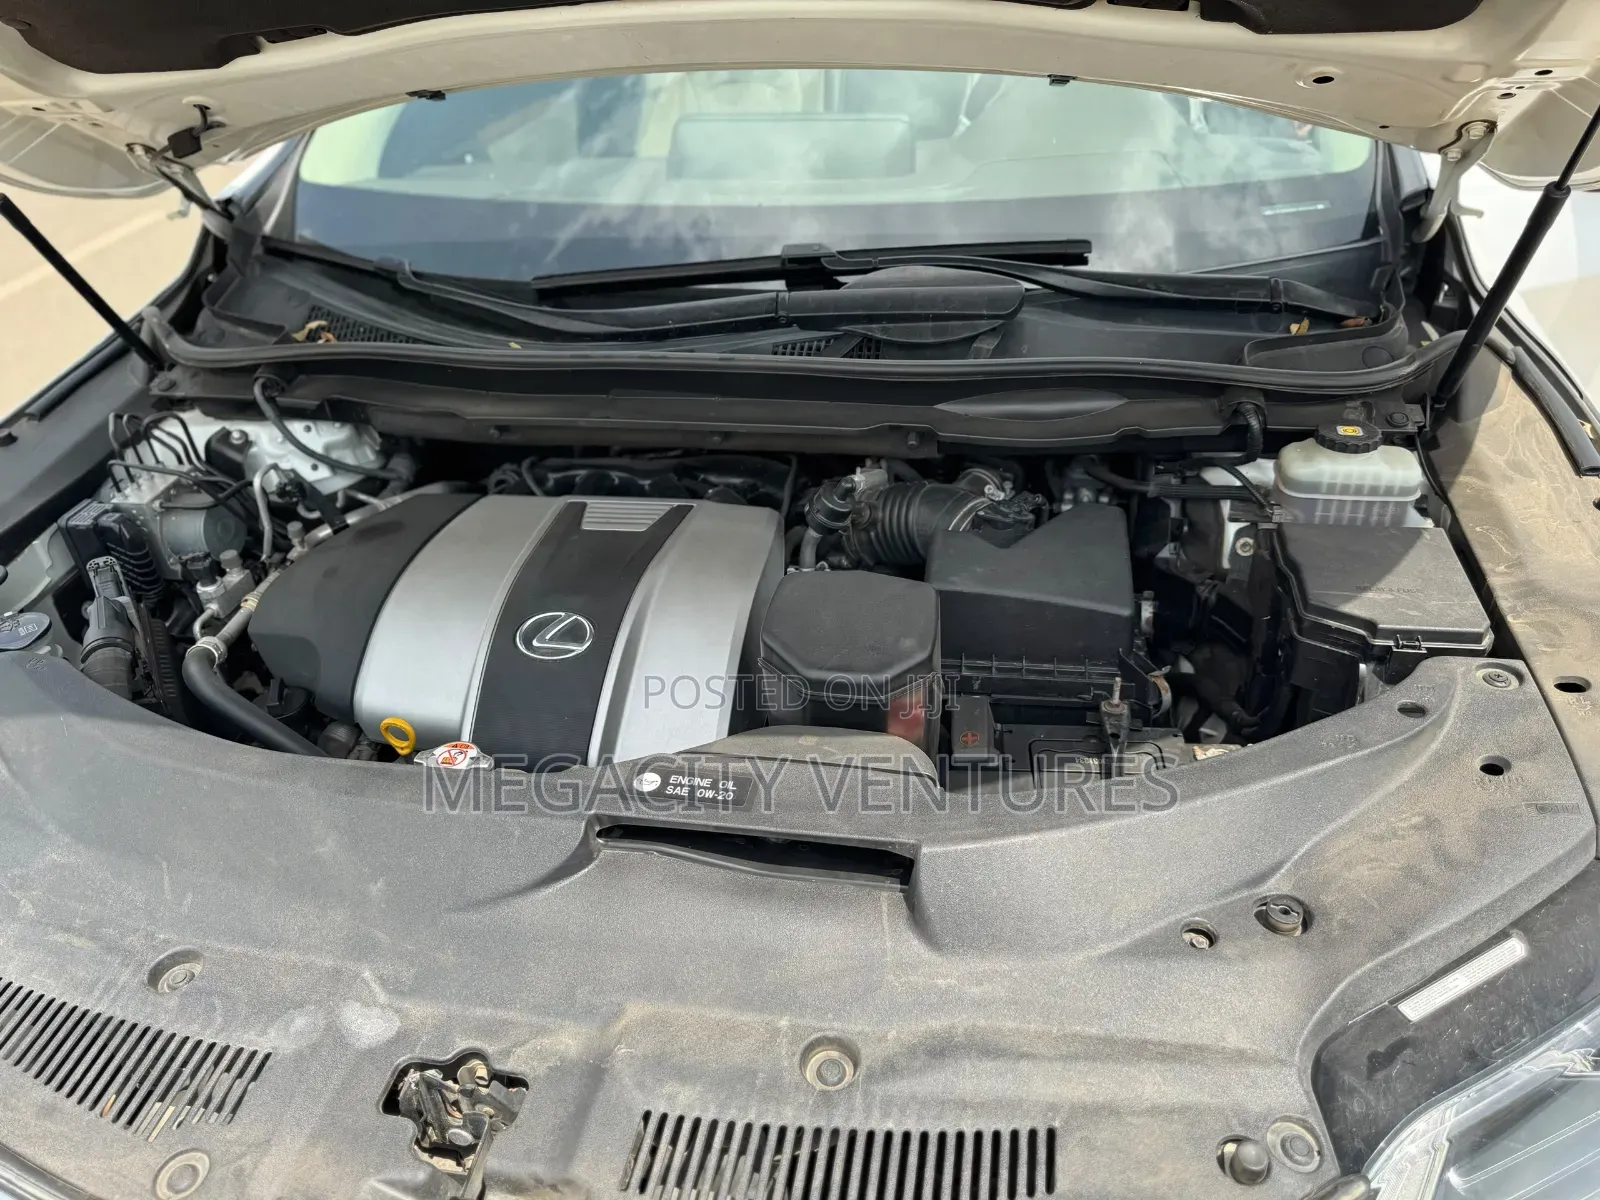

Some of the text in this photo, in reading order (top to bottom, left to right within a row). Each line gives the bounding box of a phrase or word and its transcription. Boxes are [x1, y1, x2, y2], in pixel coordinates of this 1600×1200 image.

[669, 775, 737, 790] ENGINE OIL
[665, 785, 691, 796] SAE
